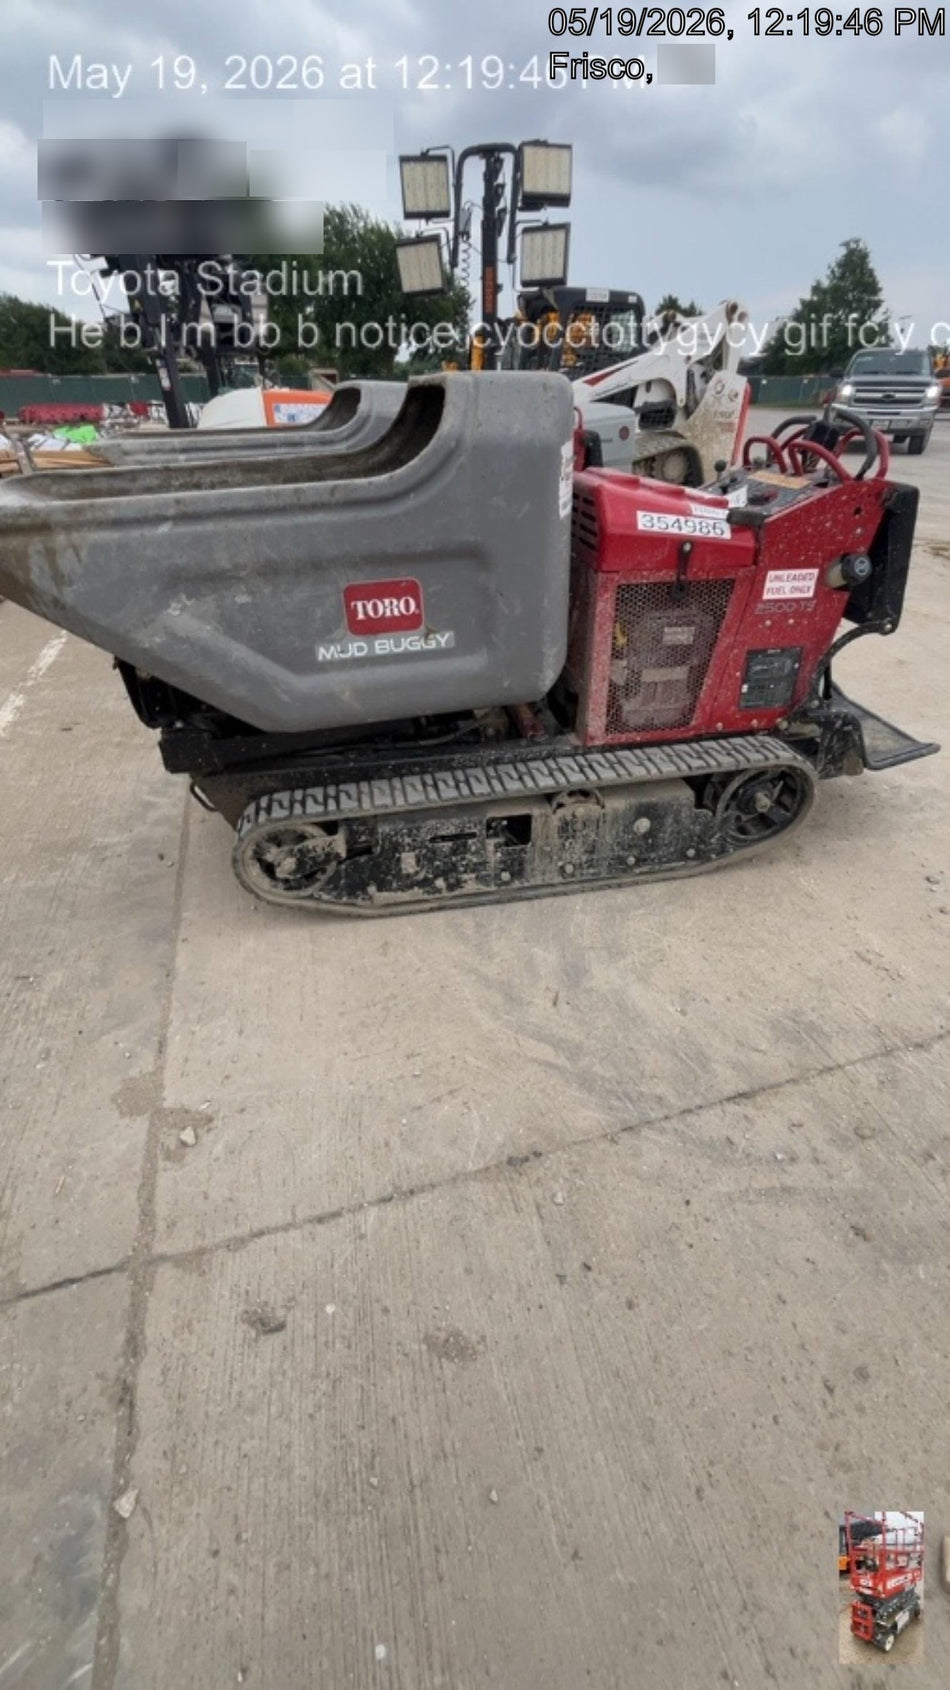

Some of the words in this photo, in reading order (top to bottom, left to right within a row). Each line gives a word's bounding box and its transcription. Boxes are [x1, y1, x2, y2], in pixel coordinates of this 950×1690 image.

[641, 513, 727, 536] 354986
[768, 572, 815, 583] UNLEADED
[766, 585, 787, 596] FUEL
[790, 585, 812, 595] ONLY
[350, 596, 416, 621] TORO
[317, 641, 369, 662] MUD
[374, 632, 451, 655] BUGGY
